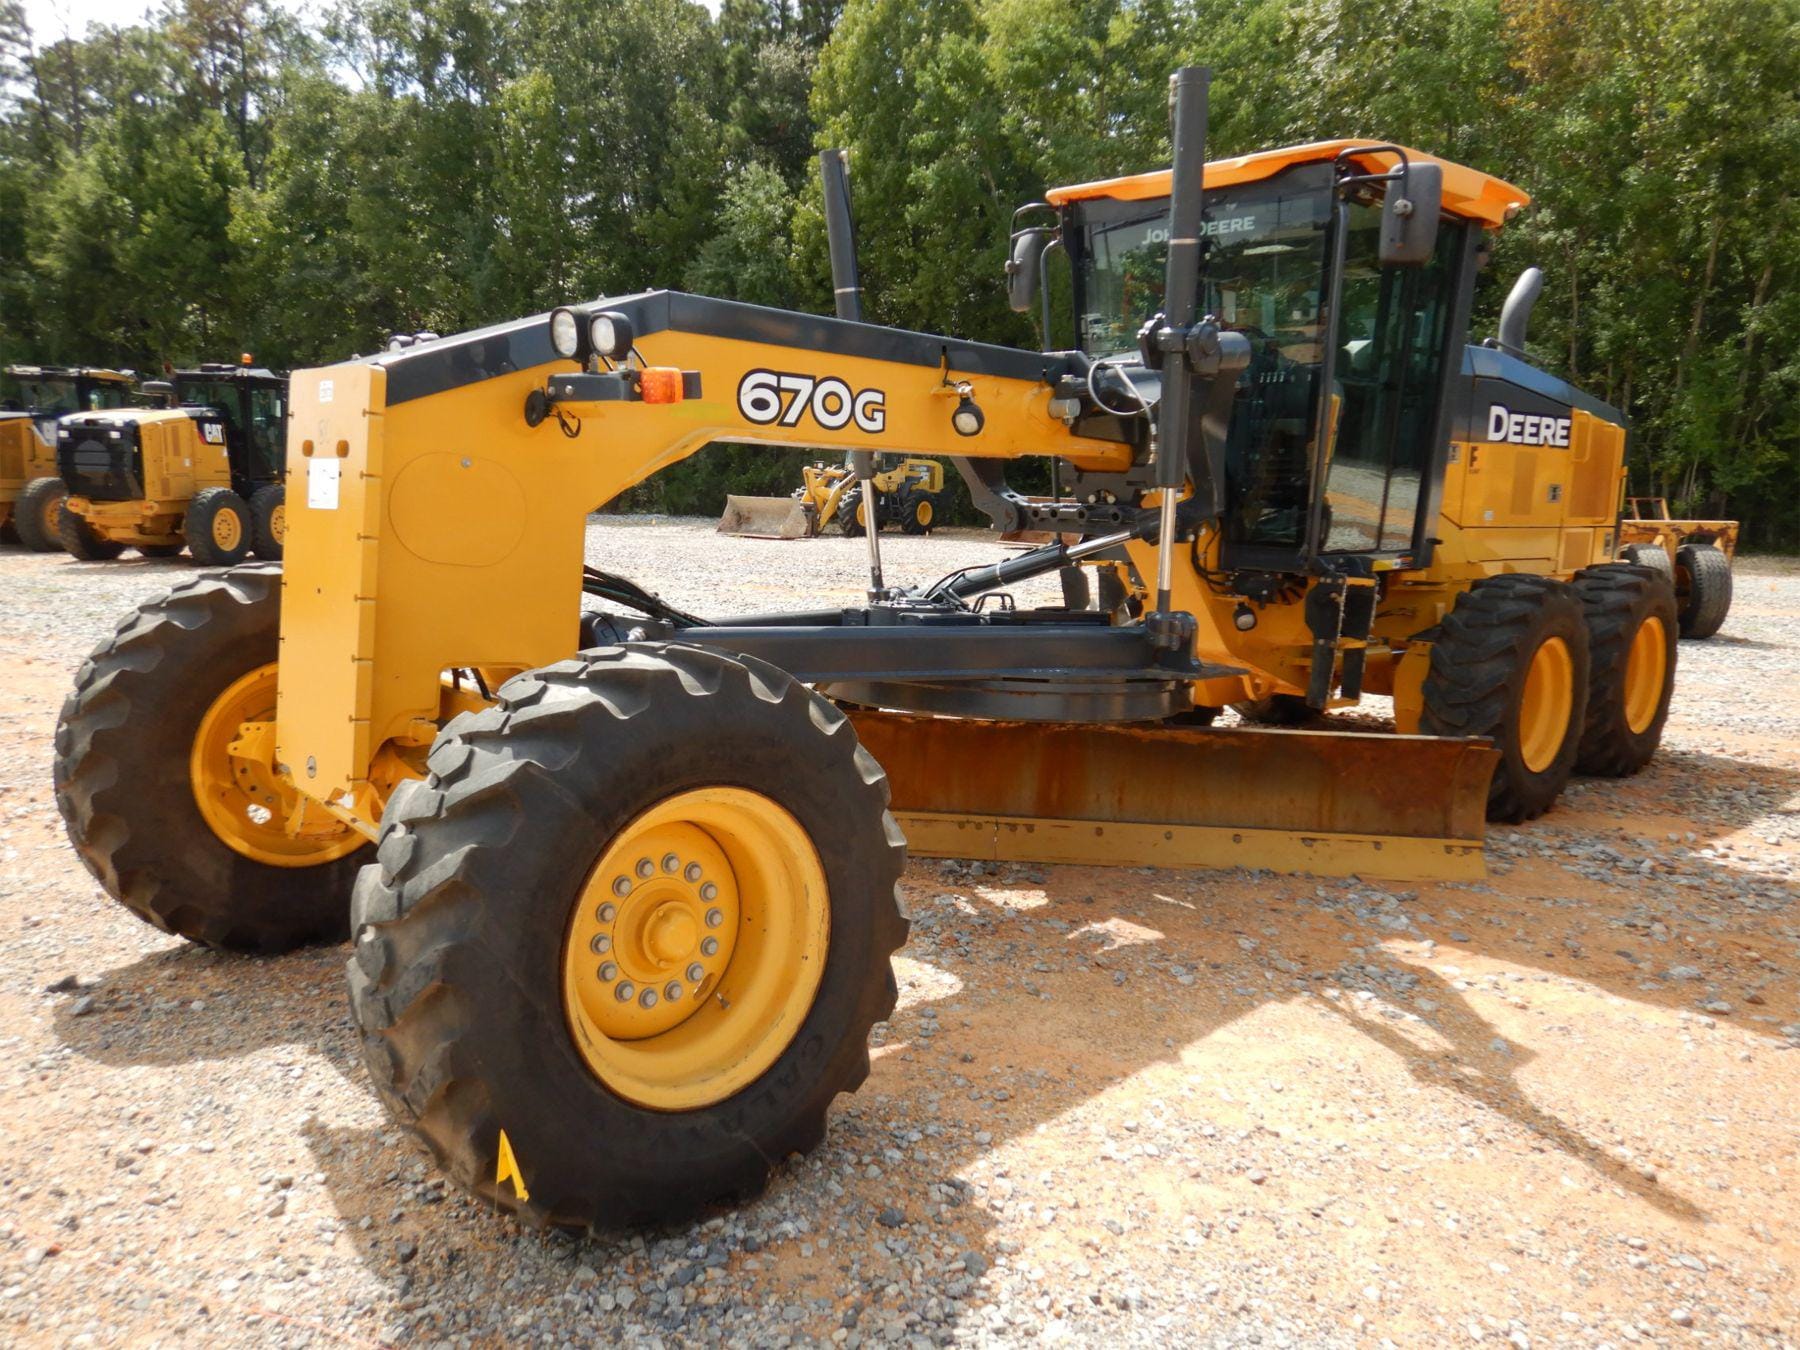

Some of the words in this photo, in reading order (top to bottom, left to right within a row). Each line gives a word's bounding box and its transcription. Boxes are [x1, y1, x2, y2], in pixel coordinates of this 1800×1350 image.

[737, 368, 886, 433] 670G
[204, 423, 223, 443] CAT
[1487, 405, 1571, 447] DEERE
